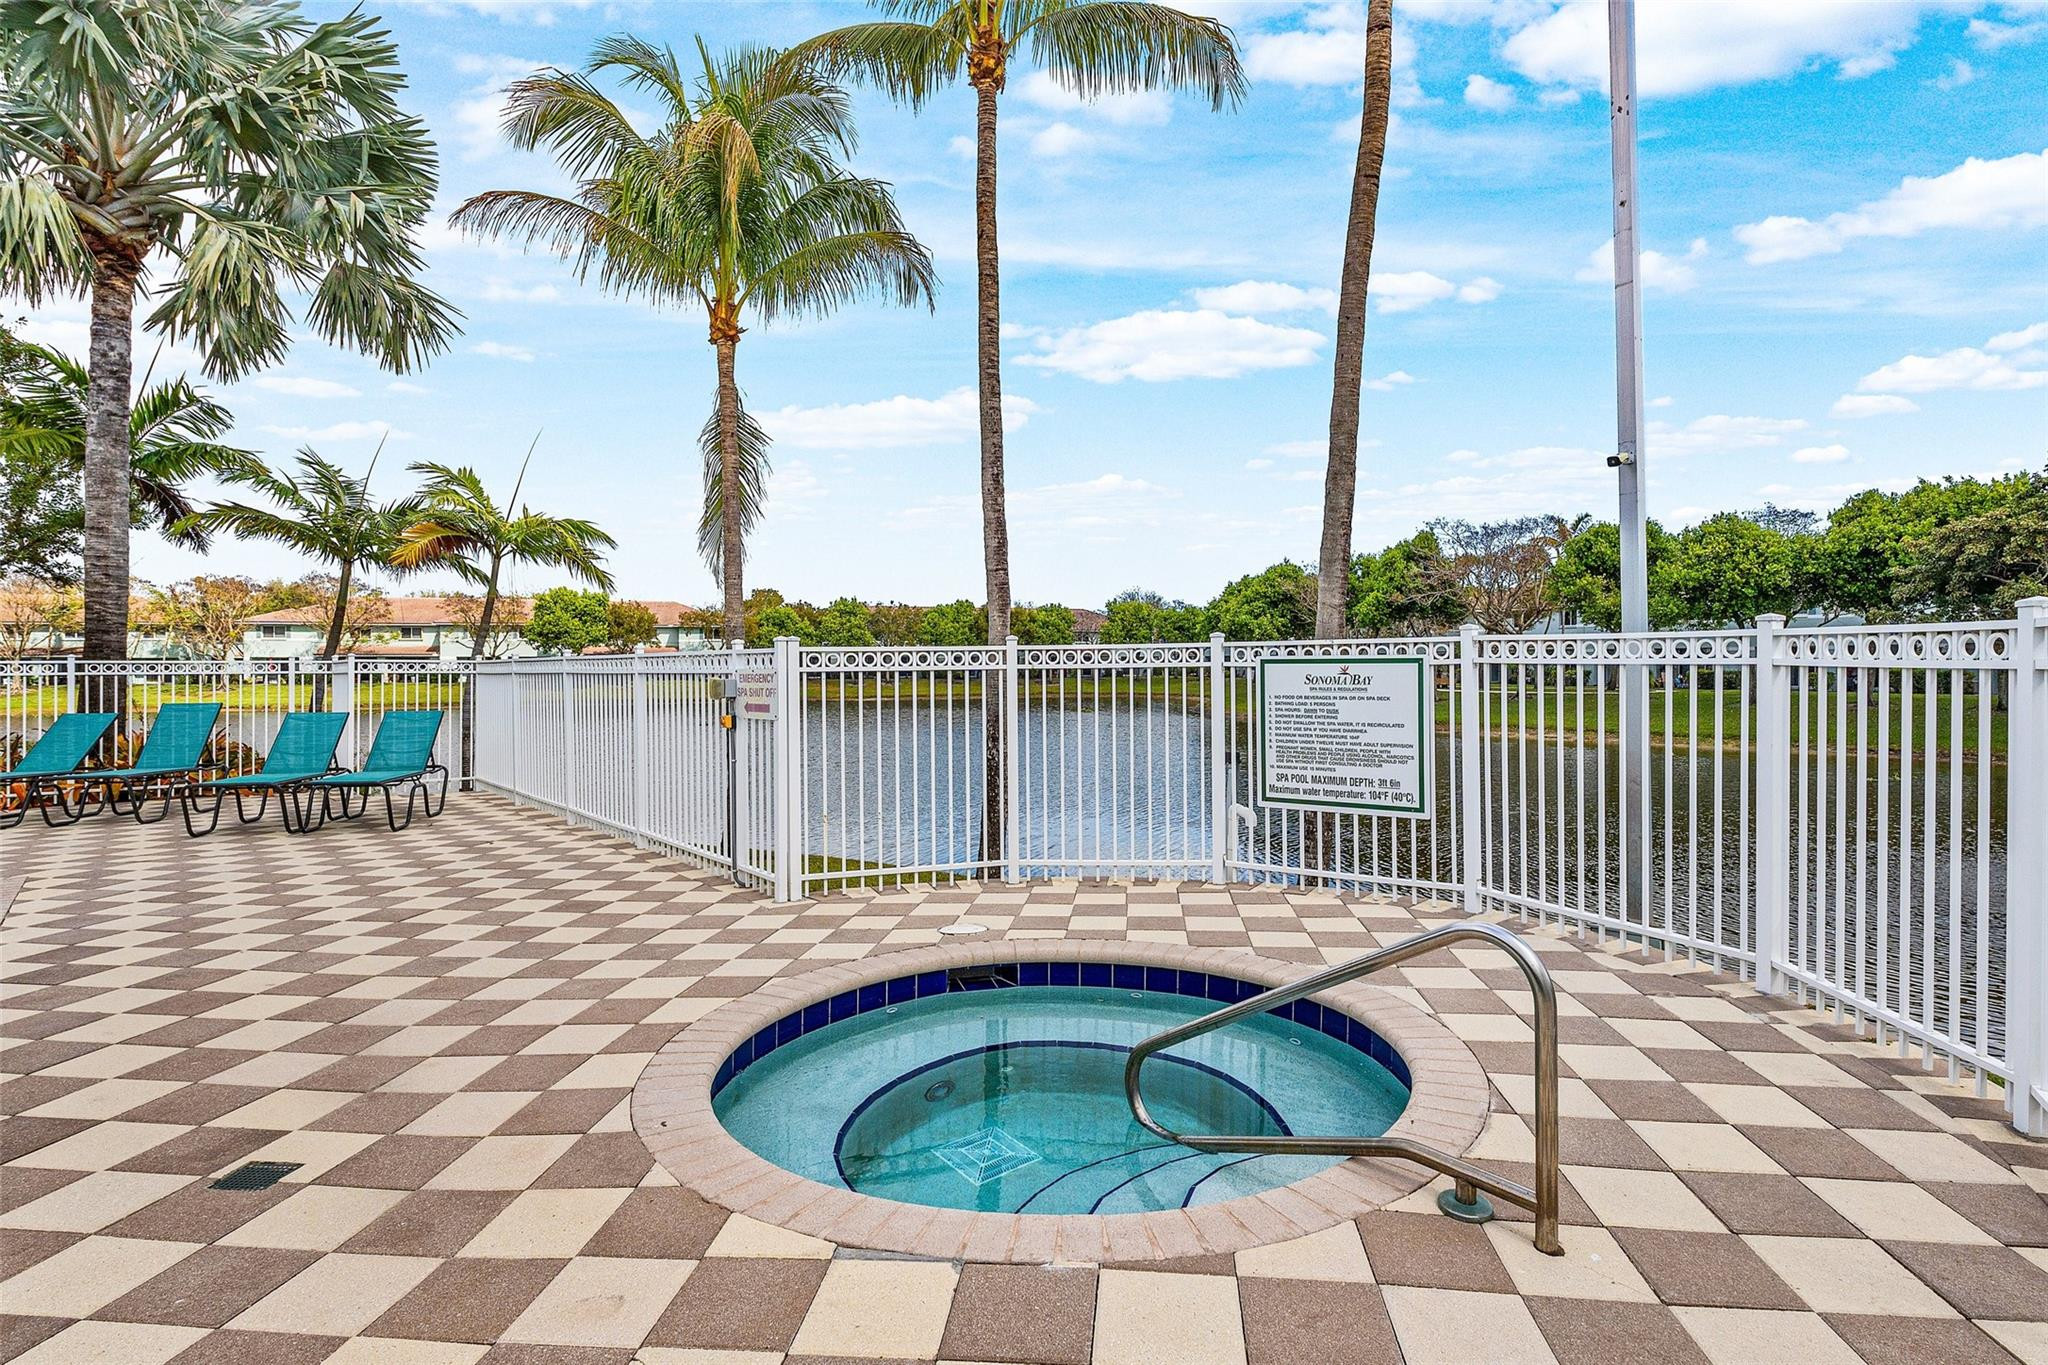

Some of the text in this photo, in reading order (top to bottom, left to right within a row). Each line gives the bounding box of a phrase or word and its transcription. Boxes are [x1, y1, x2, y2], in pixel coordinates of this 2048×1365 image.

[739, 673, 774, 683] EMERGENCY
[737, 687, 776, 697] SPA SHUT OFF
[1276, 773, 1400, 788] SPA POOL MAXIMUM DEPTH: 3ft 6in
[1269, 784, 1300, 794] Maximum
[1302, 788, 1321, 796] water
[1322, 788, 1366, 800] temperature:
